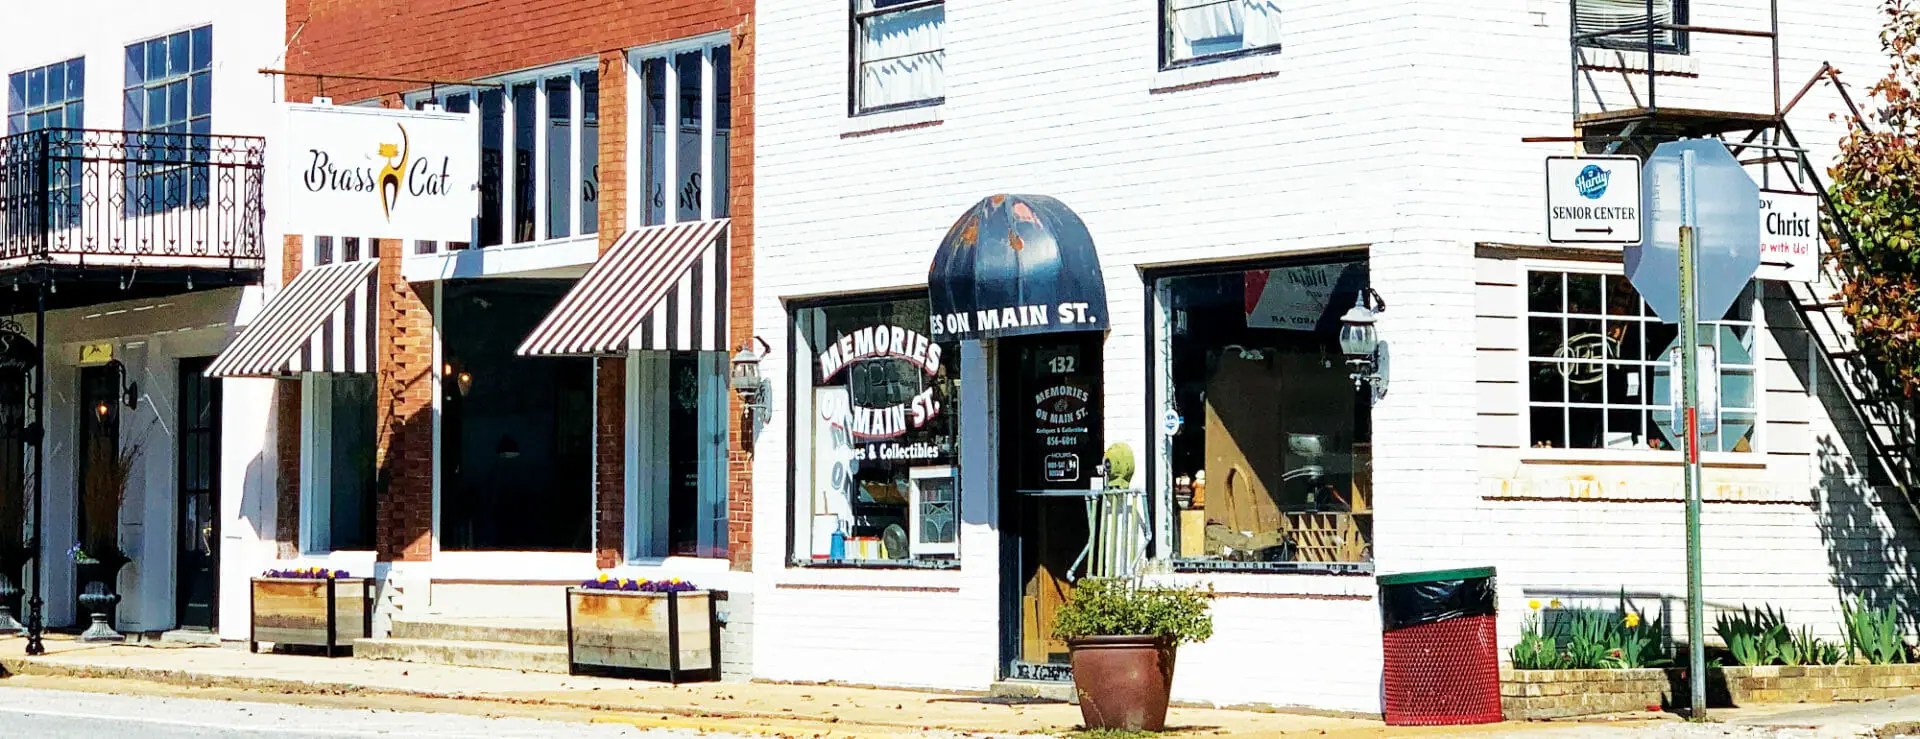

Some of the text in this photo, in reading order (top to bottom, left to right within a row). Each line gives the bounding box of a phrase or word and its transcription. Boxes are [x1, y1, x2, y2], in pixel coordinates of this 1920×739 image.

[304, 149, 453, 197] Brass Cat
[1576, 169, 1611, 195] Hardy
[1552, 206, 1636, 221] SENIOR CENTER
[1766, 211, 1810, 238] Christ
[1769, 243, 1790, 254] with
[946, 312, 970, 335] ON
[977, 304, 1049, 331] MAIN
[1057, 302, 1097, 324] ST.
[820, 324, 942, 383] MEMORIES
[1048, 355, 1075, 373] 132
[1035, 385, 1089, 405] MEMORIES
[852, 403, 906, 439] MAIN
[911, 386, 940, 428] ST.
[1049, 412, 1074, 424] MAIN
[868, 443, 877, 460] &
[879, 442, 939, 459] Collectibles
